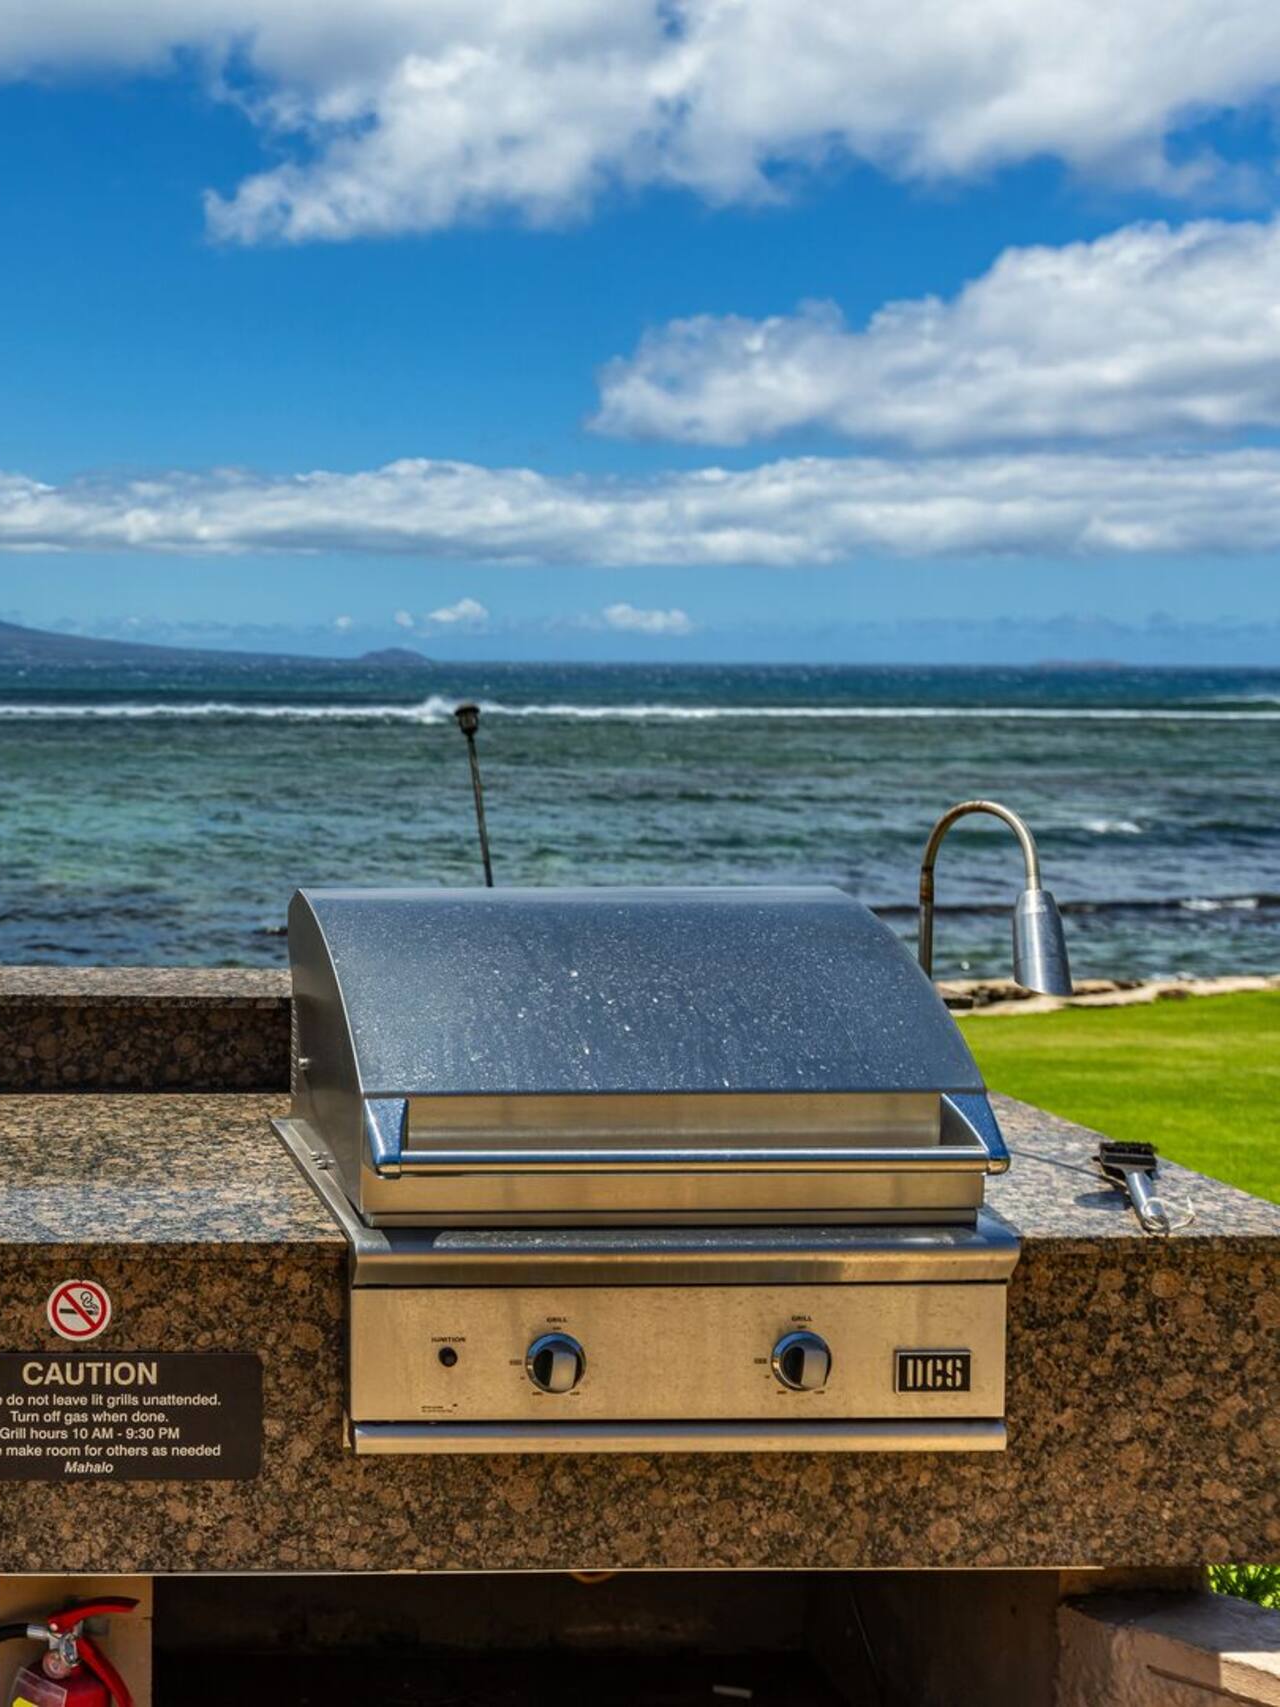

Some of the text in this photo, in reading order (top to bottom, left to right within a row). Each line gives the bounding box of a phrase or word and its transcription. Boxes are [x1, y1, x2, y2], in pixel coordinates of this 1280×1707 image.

[431, 1335, 466, 1343] IGNITION
[22, 1361, 158, 1386] CAUTION
[906, 1358, 963, 1388] DCS
[6, 1393, 24, 1406] do
[28, 1393, 49, 1406] not
[53, 1393, 88, 1406] leave
[91, 1393, 103, 1406] lit
[107, 1393, 139, 1409] grills
[142, 1393, 222, 1406] unattended.
[10, 1410, 169, 1426] Turn off gas when done.
[30, 1427, 68, 1440] hours
[72, 1427, 88, 1440] 10
[91, 1427, 114, 1440] AM
[125, 1427, 155, 1440] 9:30
[159, 1427, 180, 1440] PM
[6, 1444, 43, 1457] make
[46, 1447, 81, 1457] room
[84, 1444, 102, 1457] for
[106, 1444, 148, 1457] others
[152, 1447, 168, 1457] as
[172, 1444, 221, 1457] needed
[64, 1461, 114, 1474] Mahalo
